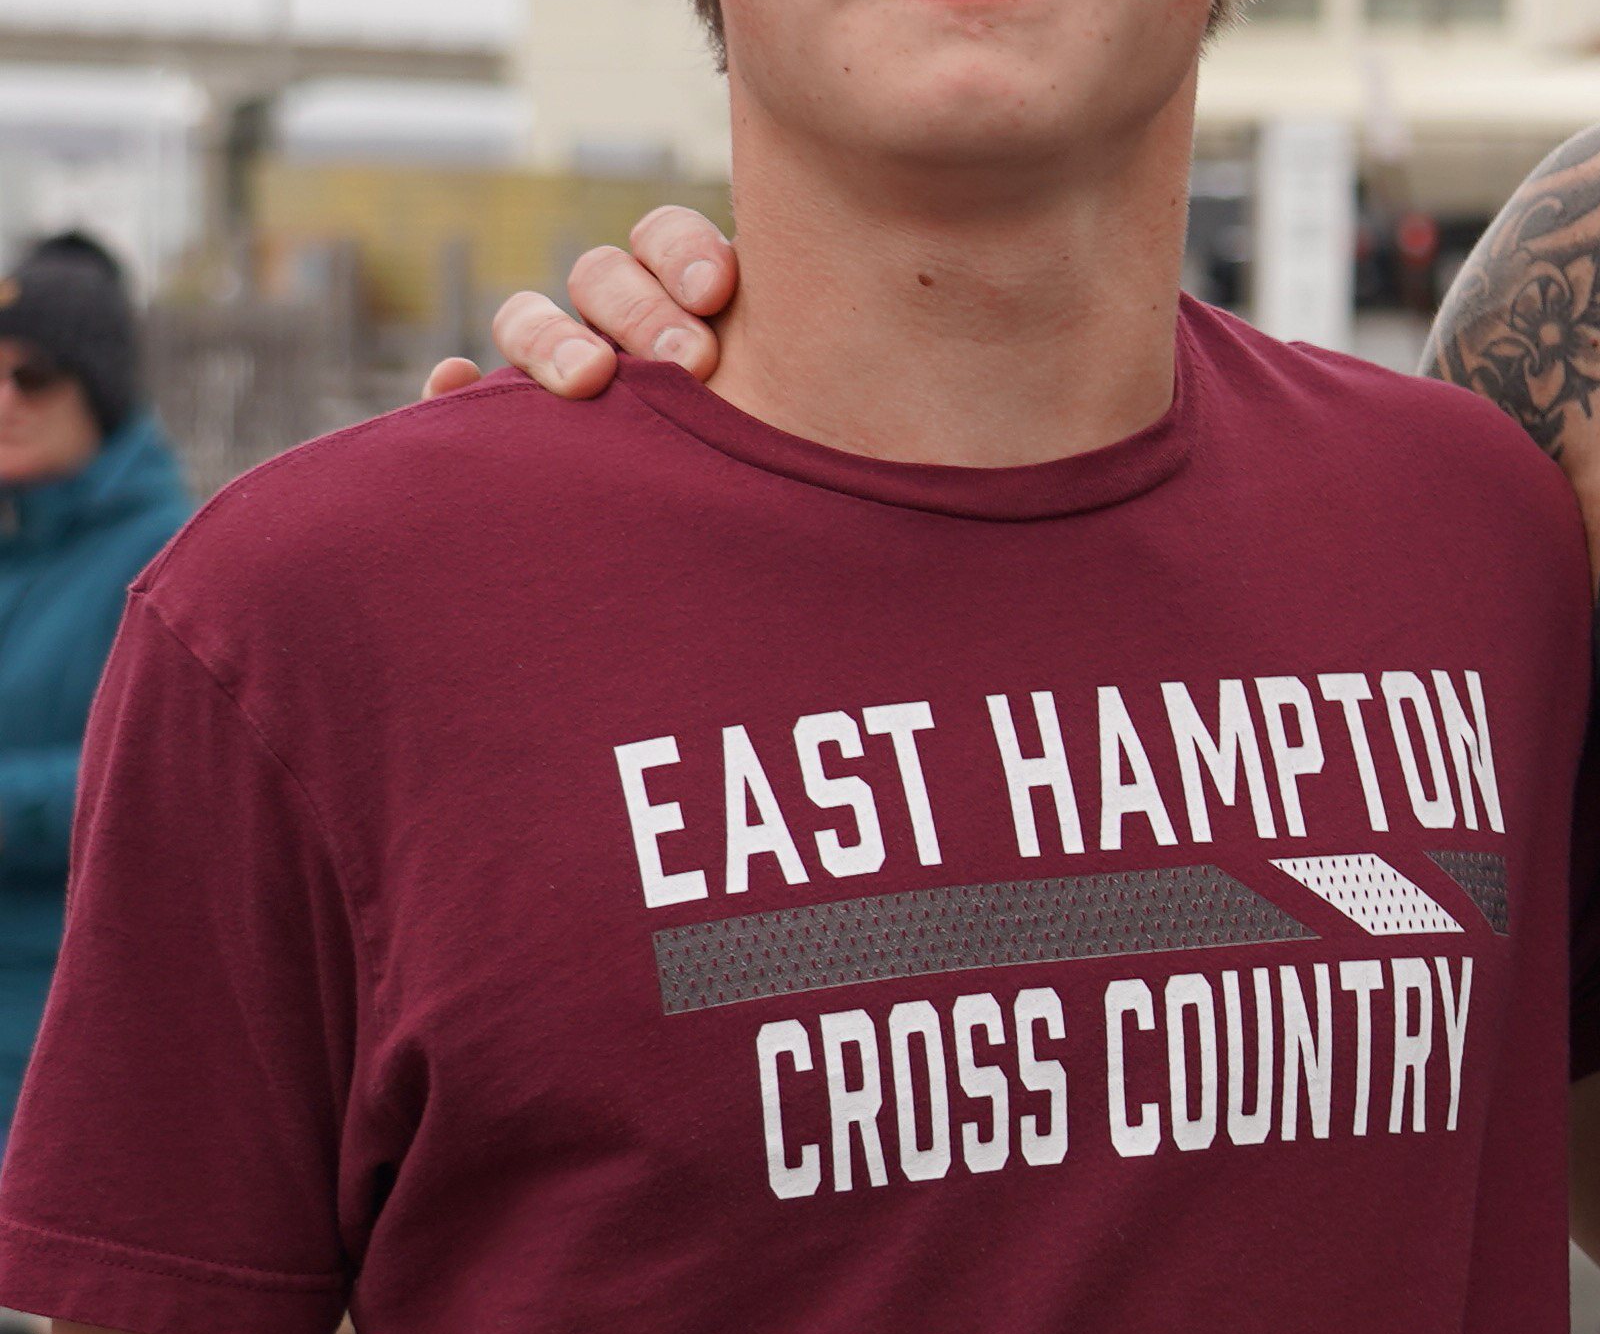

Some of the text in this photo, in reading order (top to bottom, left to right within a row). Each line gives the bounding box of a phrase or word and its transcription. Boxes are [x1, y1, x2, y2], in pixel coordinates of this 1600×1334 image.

[614, 669, 1506, 909] EAST HAMPTON
[756, 956, 1474, 1200] CROSS COUNTRY
